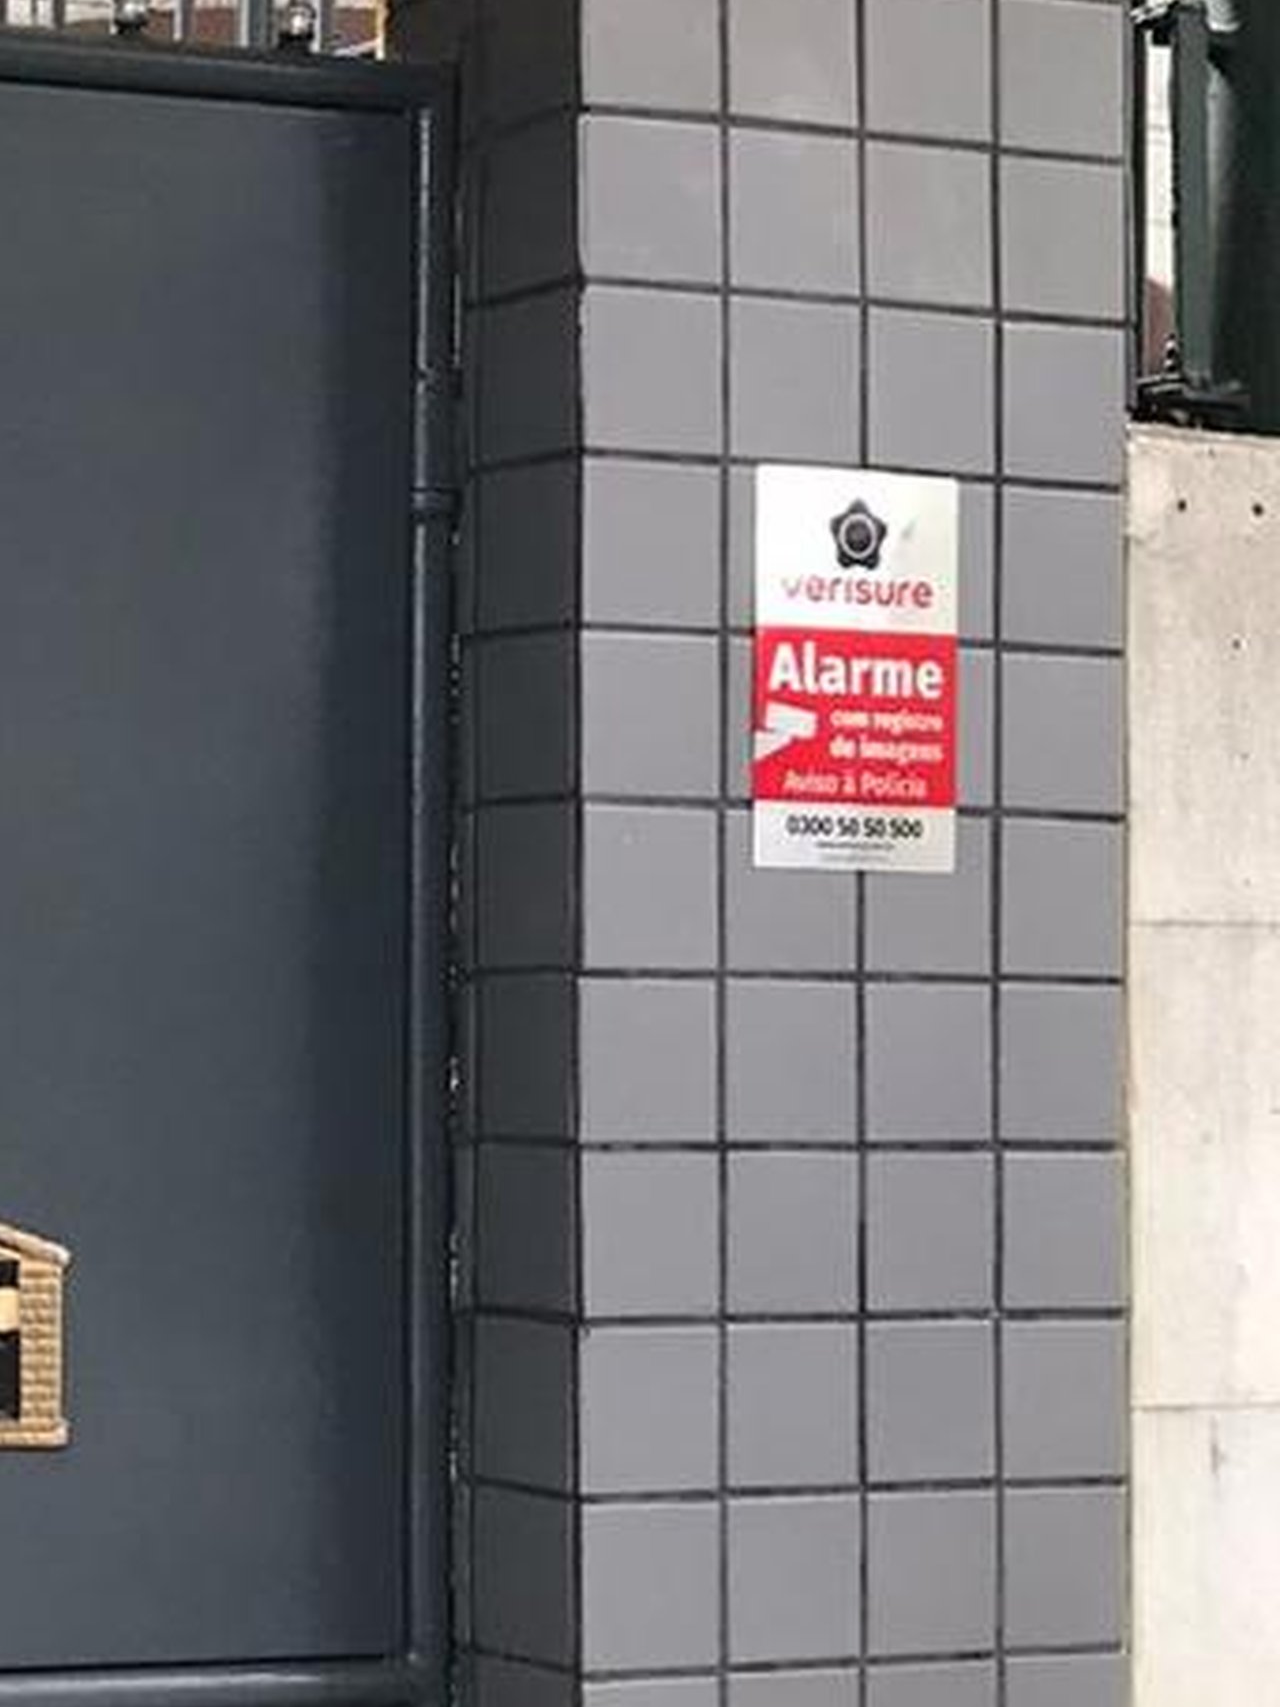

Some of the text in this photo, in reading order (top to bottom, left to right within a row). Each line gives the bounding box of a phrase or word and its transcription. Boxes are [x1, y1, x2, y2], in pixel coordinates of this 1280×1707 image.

[780, 575, 935, 609] verisure
[768, 641, 943, 700] Alarme
[829, 734, 943, 765] de imagens
[837, 816, 860, 837] 50
[864, 816, 887, 838] 50
